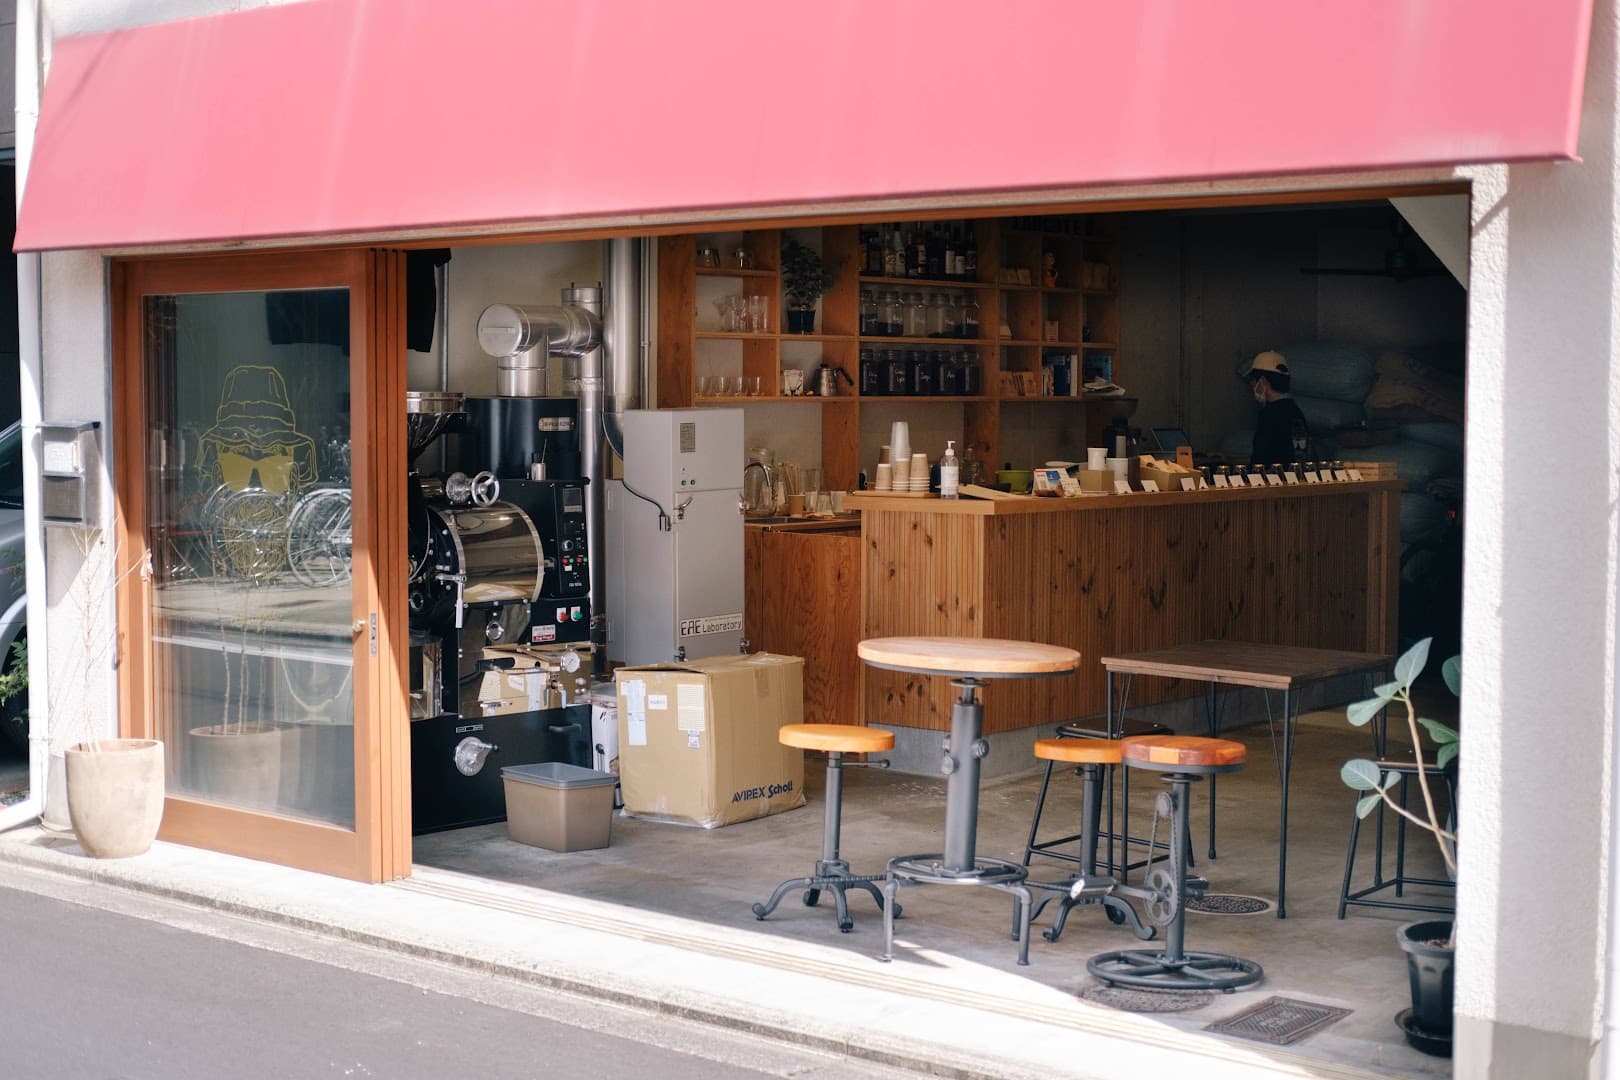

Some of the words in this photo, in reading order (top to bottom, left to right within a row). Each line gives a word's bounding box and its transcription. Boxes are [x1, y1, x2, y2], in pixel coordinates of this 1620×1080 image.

[703, 621, 742, 633] Laboratory
[732, 786, 766, 803] AVIREX
[768, 780, 793, 798] Scholl
